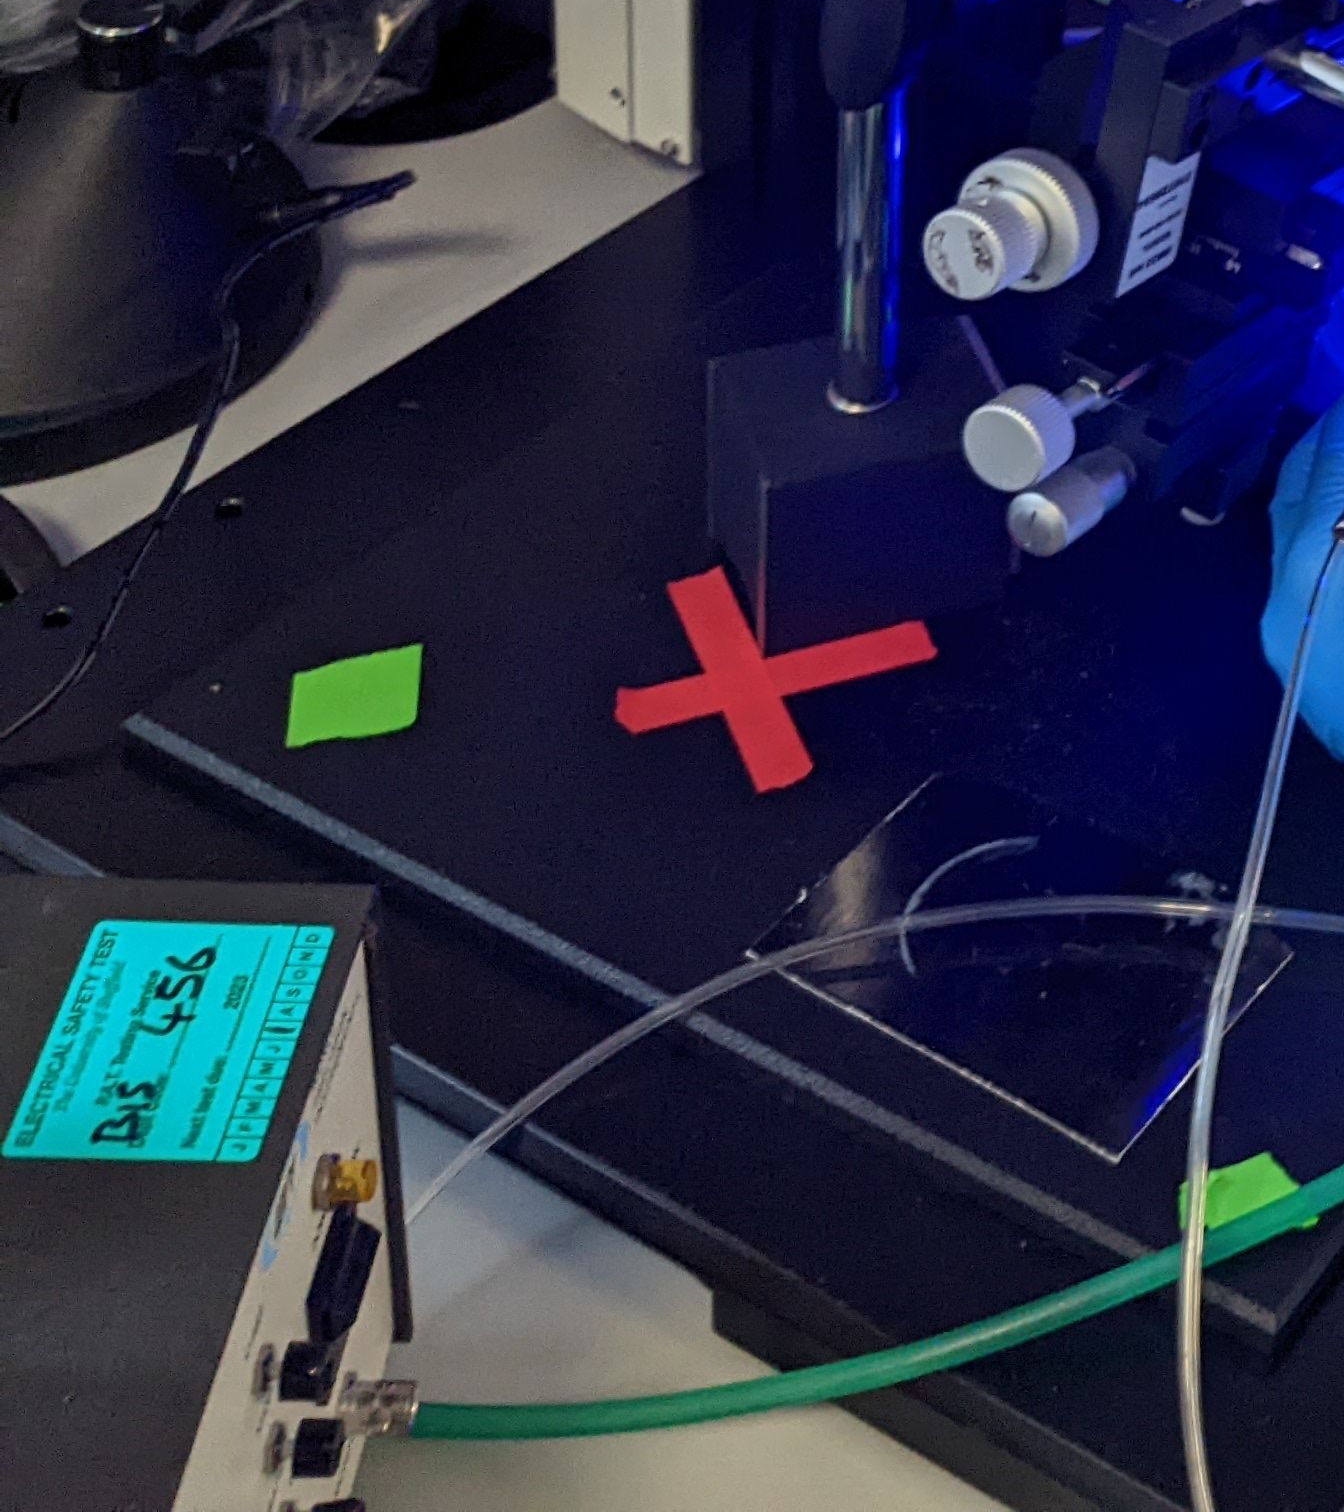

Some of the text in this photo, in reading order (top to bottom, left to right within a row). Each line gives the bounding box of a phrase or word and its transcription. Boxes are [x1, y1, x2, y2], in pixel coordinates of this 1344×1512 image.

[15, 930, 120, 1147] ELECTRICAL SAFETY TEST
[136, 946, 220, 1036] 456
